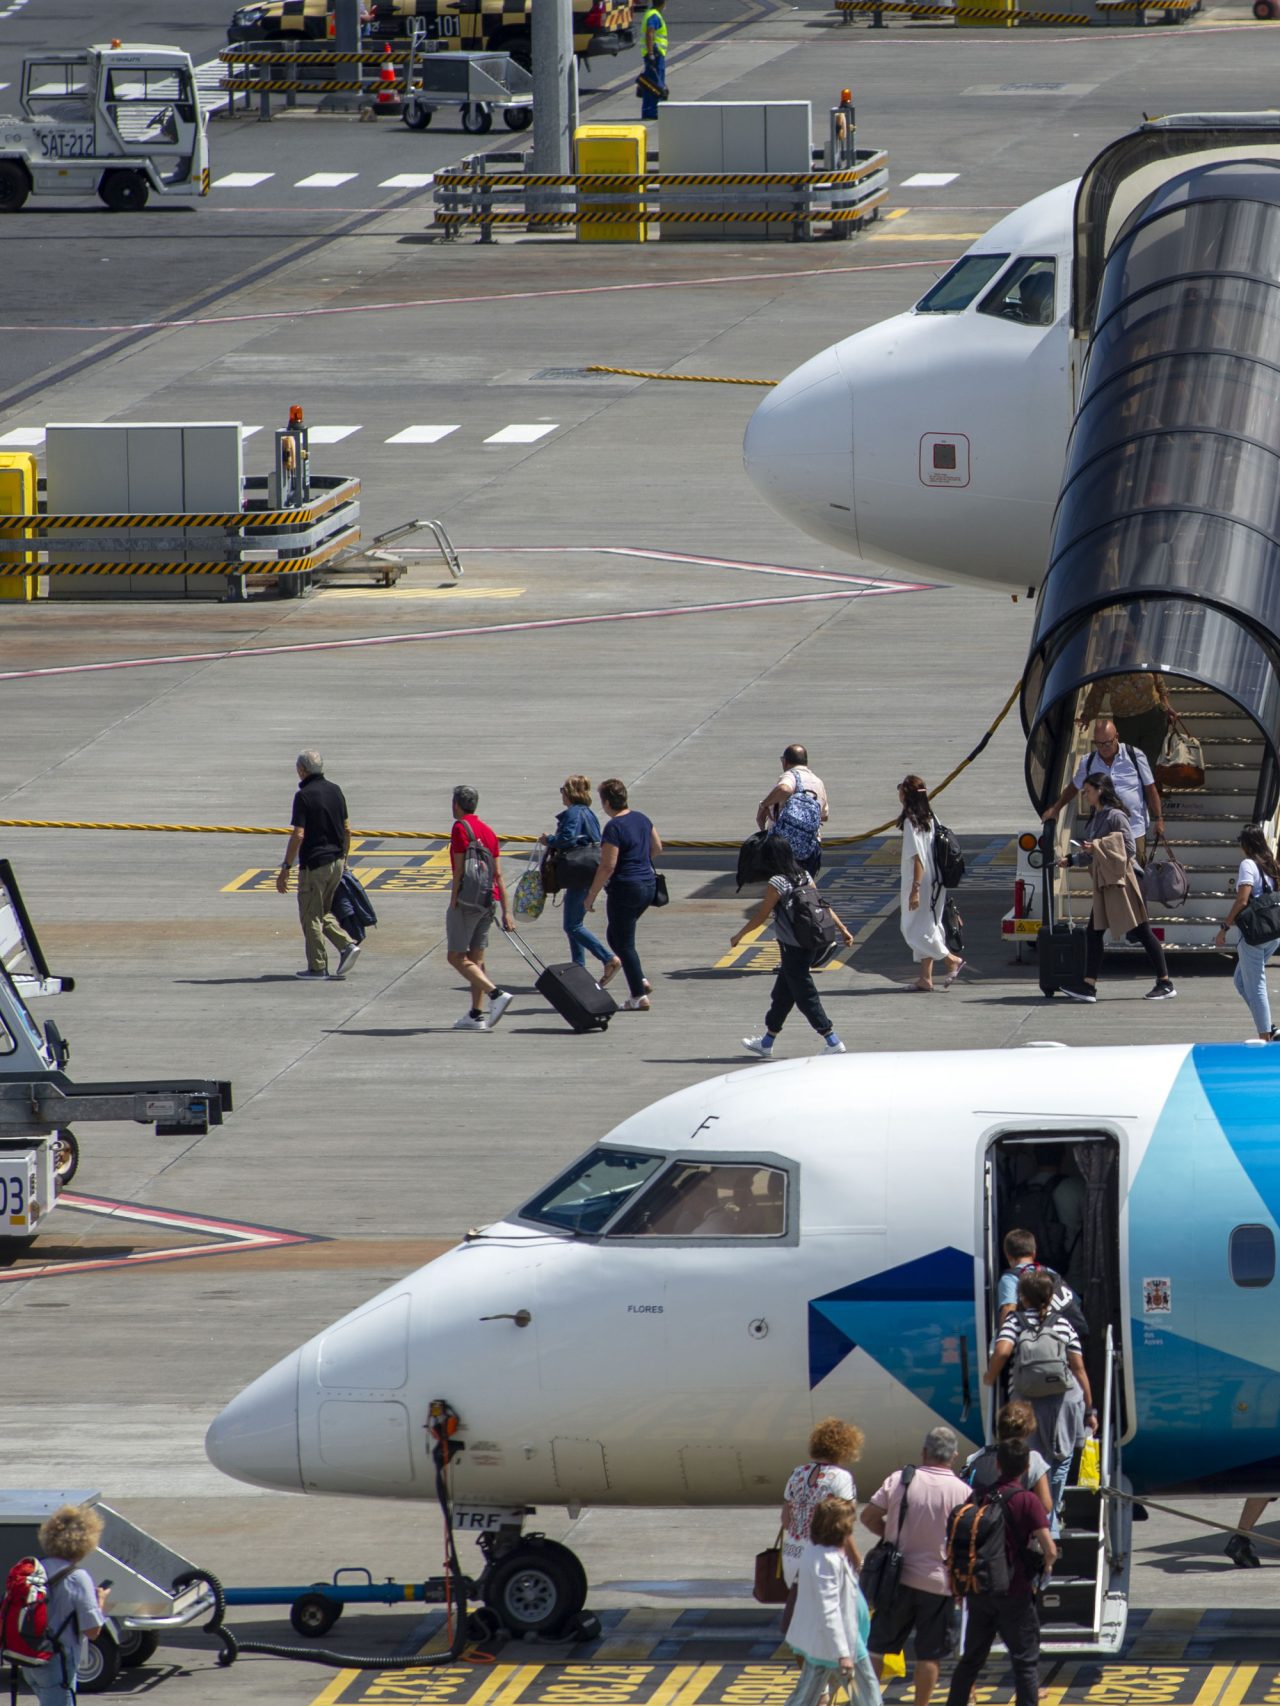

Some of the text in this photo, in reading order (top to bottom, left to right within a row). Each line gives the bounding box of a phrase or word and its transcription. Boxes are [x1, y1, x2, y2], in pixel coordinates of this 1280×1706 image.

[41, 133, 94, 156] SAT-212
[691, 1115, 720, 1139] F
[627, 1304, 664, 1314] FLORES
[1046, 1285, 1074, 1316] ILA
[456, 1512, 501, 1528] TRF
[538, 1665, 656, 1703] B738
[1083, 1665, 1191, 1704] A320
